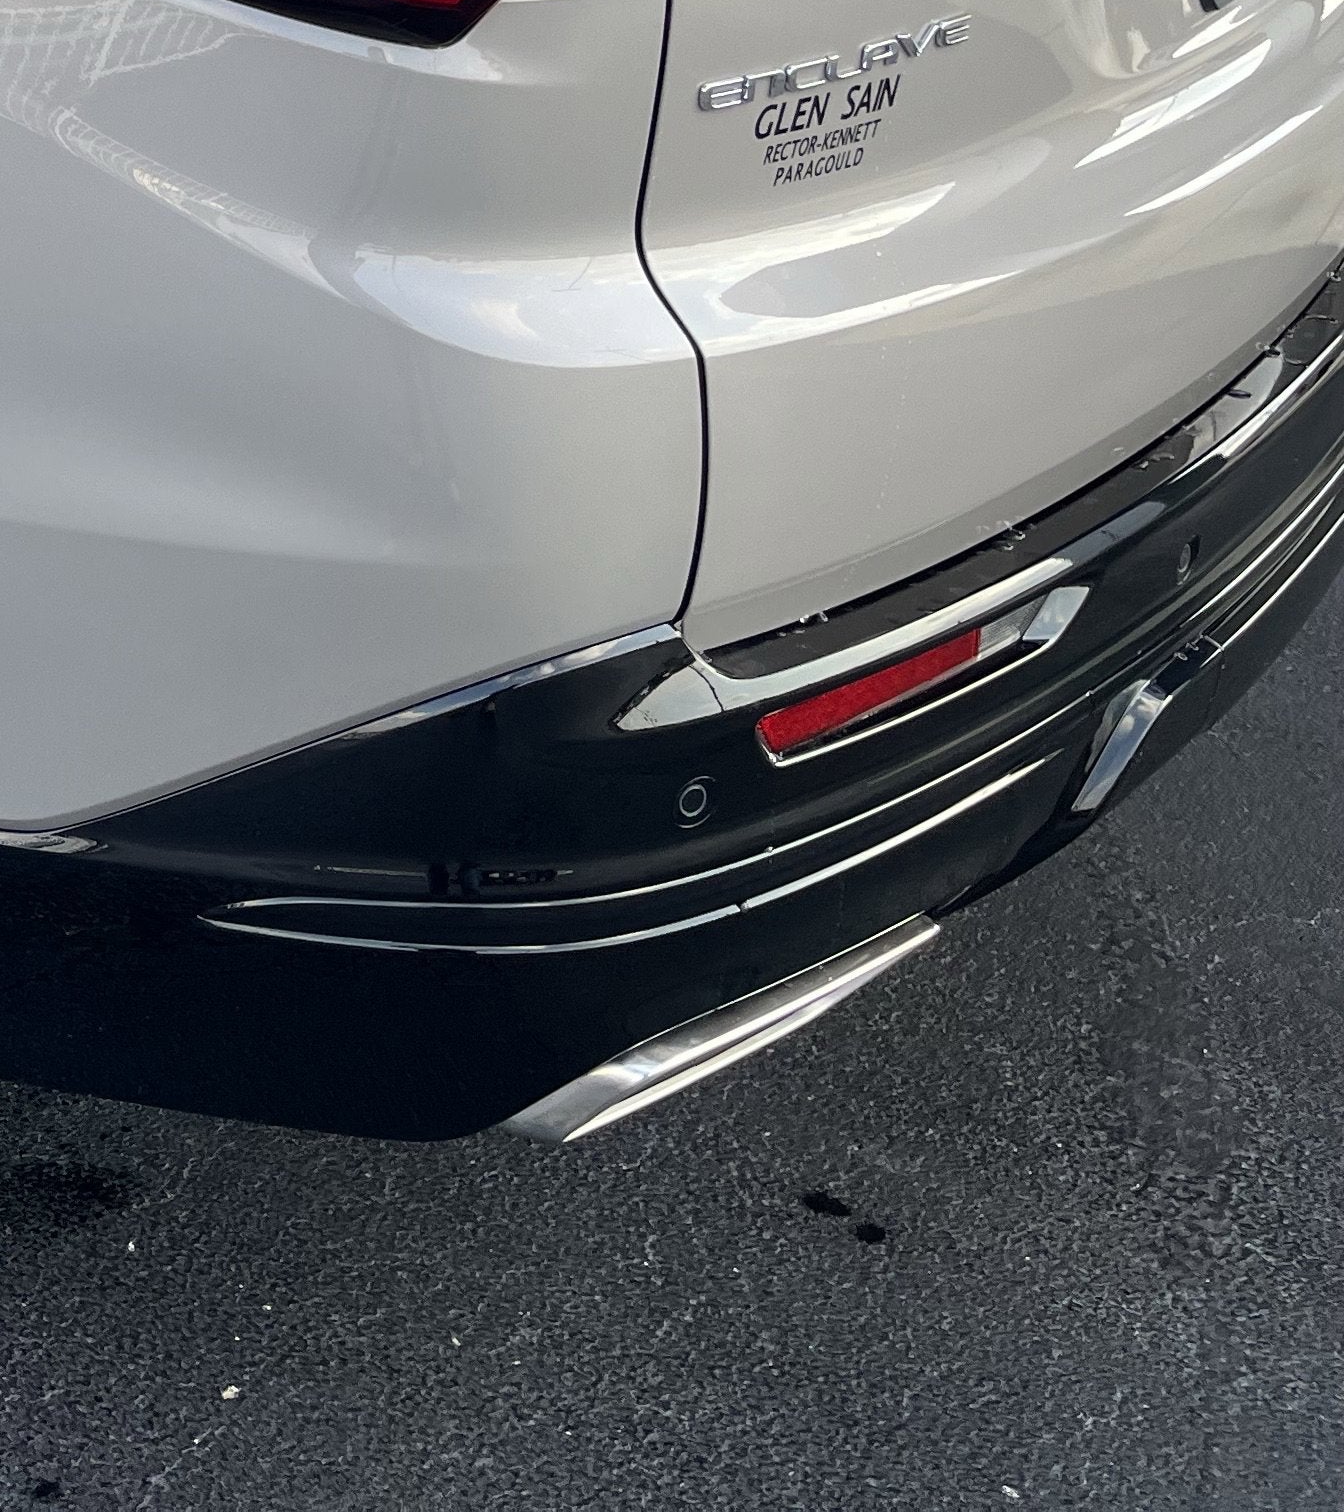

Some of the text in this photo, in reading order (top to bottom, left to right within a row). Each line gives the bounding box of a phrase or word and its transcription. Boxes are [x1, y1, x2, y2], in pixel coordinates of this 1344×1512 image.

[697, 13, 973, 111] ENCLAVE
[754, 74, 901, 140] GLEN SAIN
[762, 118, 882, 167] RECTOR-KENNETT
[773, 147, 865, 187] PARAGOULD
